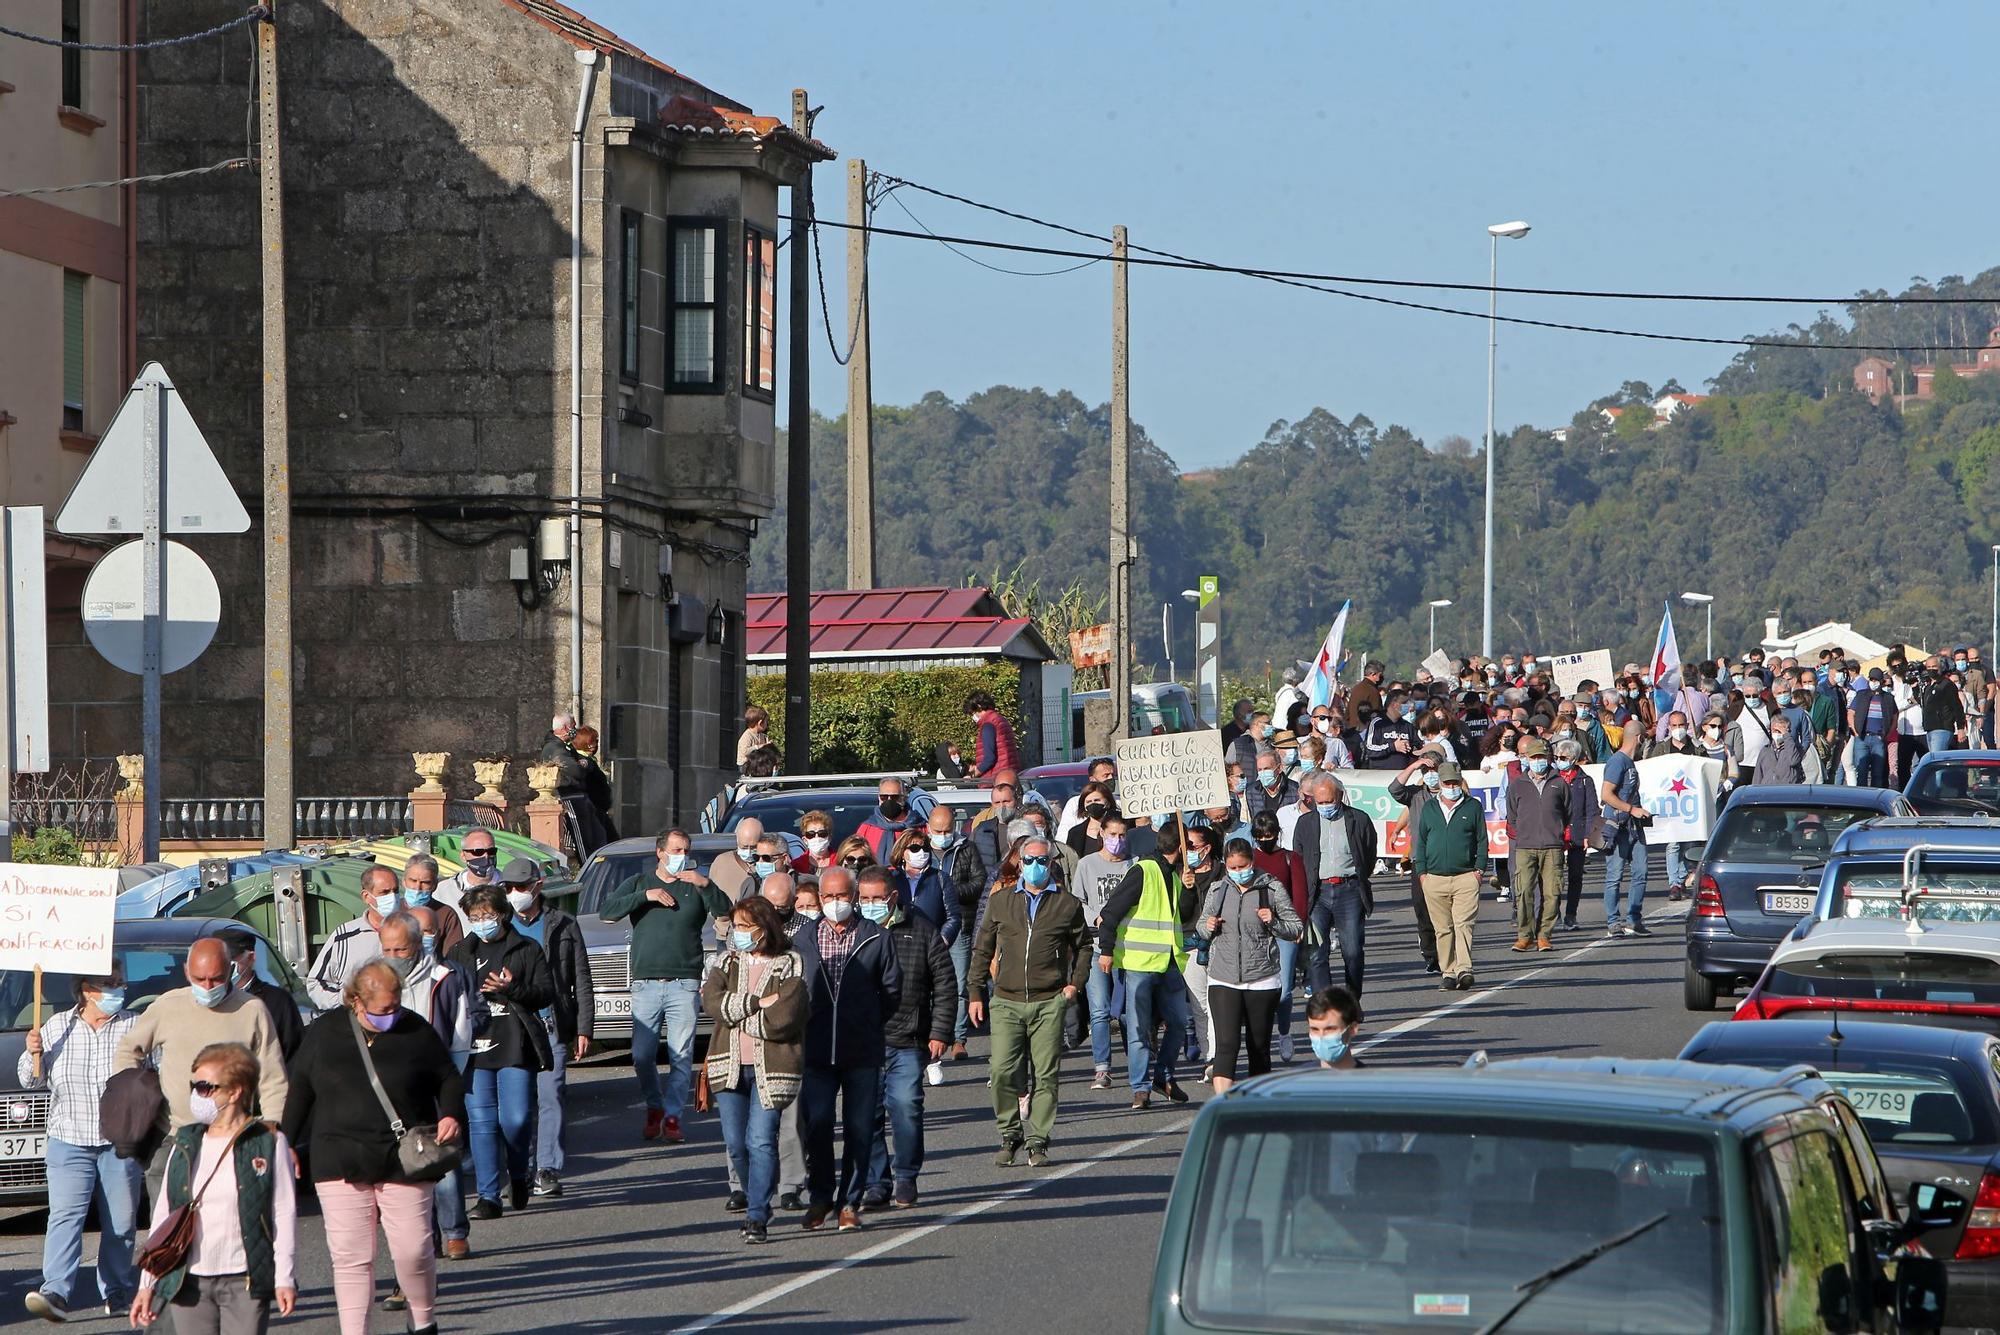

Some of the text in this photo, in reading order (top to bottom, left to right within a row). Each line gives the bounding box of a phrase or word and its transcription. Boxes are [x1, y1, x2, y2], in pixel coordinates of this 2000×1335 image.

[1117, 737, 1198, 761] CHAPELA
[1120, 757, 1219, 782] ABANDONADA
[1128, 792, 1216, 815] CABREADA
[1775, 896, 1809, 909] 8539
[47, 905, 60, 922] A
[0, 931, 104, 950] ONIFICACIÓN
[596, 1000, 631, 1013] PO 98
[1853, 1092, 1906, 1111] 2769
[4, 1137, 45, 1156] 37 F
